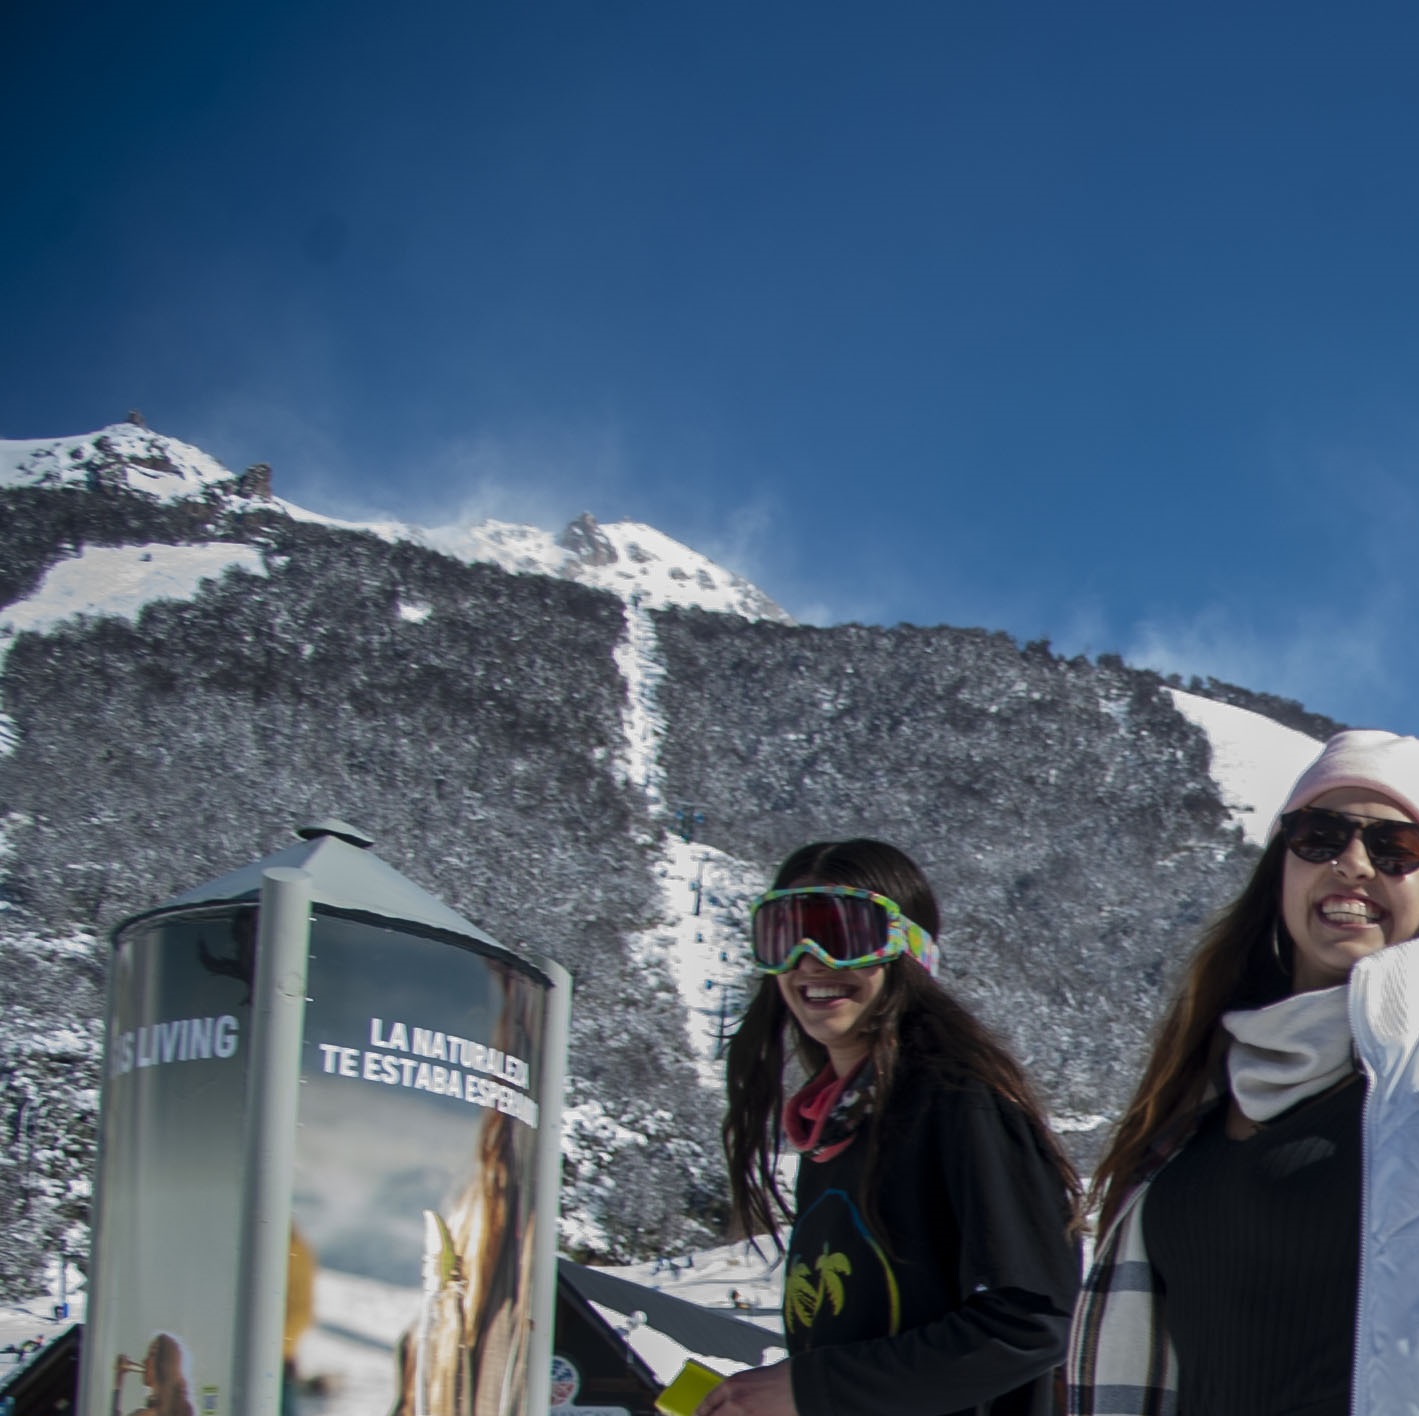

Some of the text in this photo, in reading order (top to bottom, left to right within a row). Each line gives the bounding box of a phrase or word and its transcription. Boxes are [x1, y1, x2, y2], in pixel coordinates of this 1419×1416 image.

[136, 1014, 240, 1068] LIVING
[370, 1017, 409, 1051] LA
[319, 1043, 360, 1078] TE
[363, 1051, 464, 1100] ESTABA
